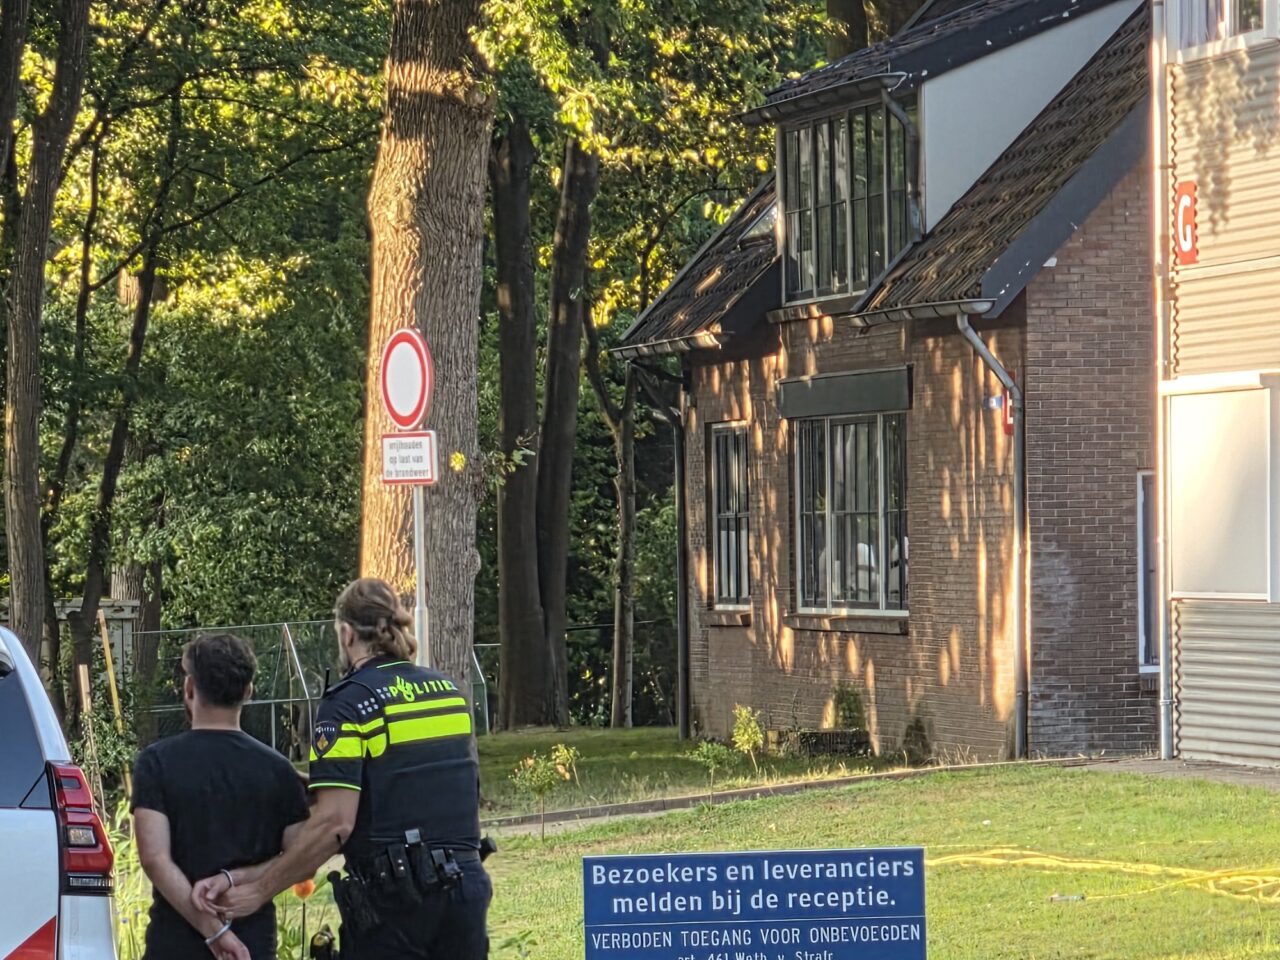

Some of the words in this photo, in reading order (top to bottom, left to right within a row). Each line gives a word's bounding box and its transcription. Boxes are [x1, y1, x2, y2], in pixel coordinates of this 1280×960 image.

[1177, 194, 1193, 252] G
[390, 676, 451, 701] POLITIE
[592, 862, 718, 885] Bezoekers
[726, 864, 754, 881] en
[763, 856, 914, 880] leveranciers
[613, 891, 702, 913] melden
[712, 889, 741, 915] bij
[750, 888, 778, 909] de
[788, 885, 896, 912] receptie.
[592, 931, 672, 949] VERBODEN
[681, 929, 752, 947] TOEGANG
[760, 928, 800, 945] VOOR
[809, 924, 920, 943] ONBEVOEGDEN
